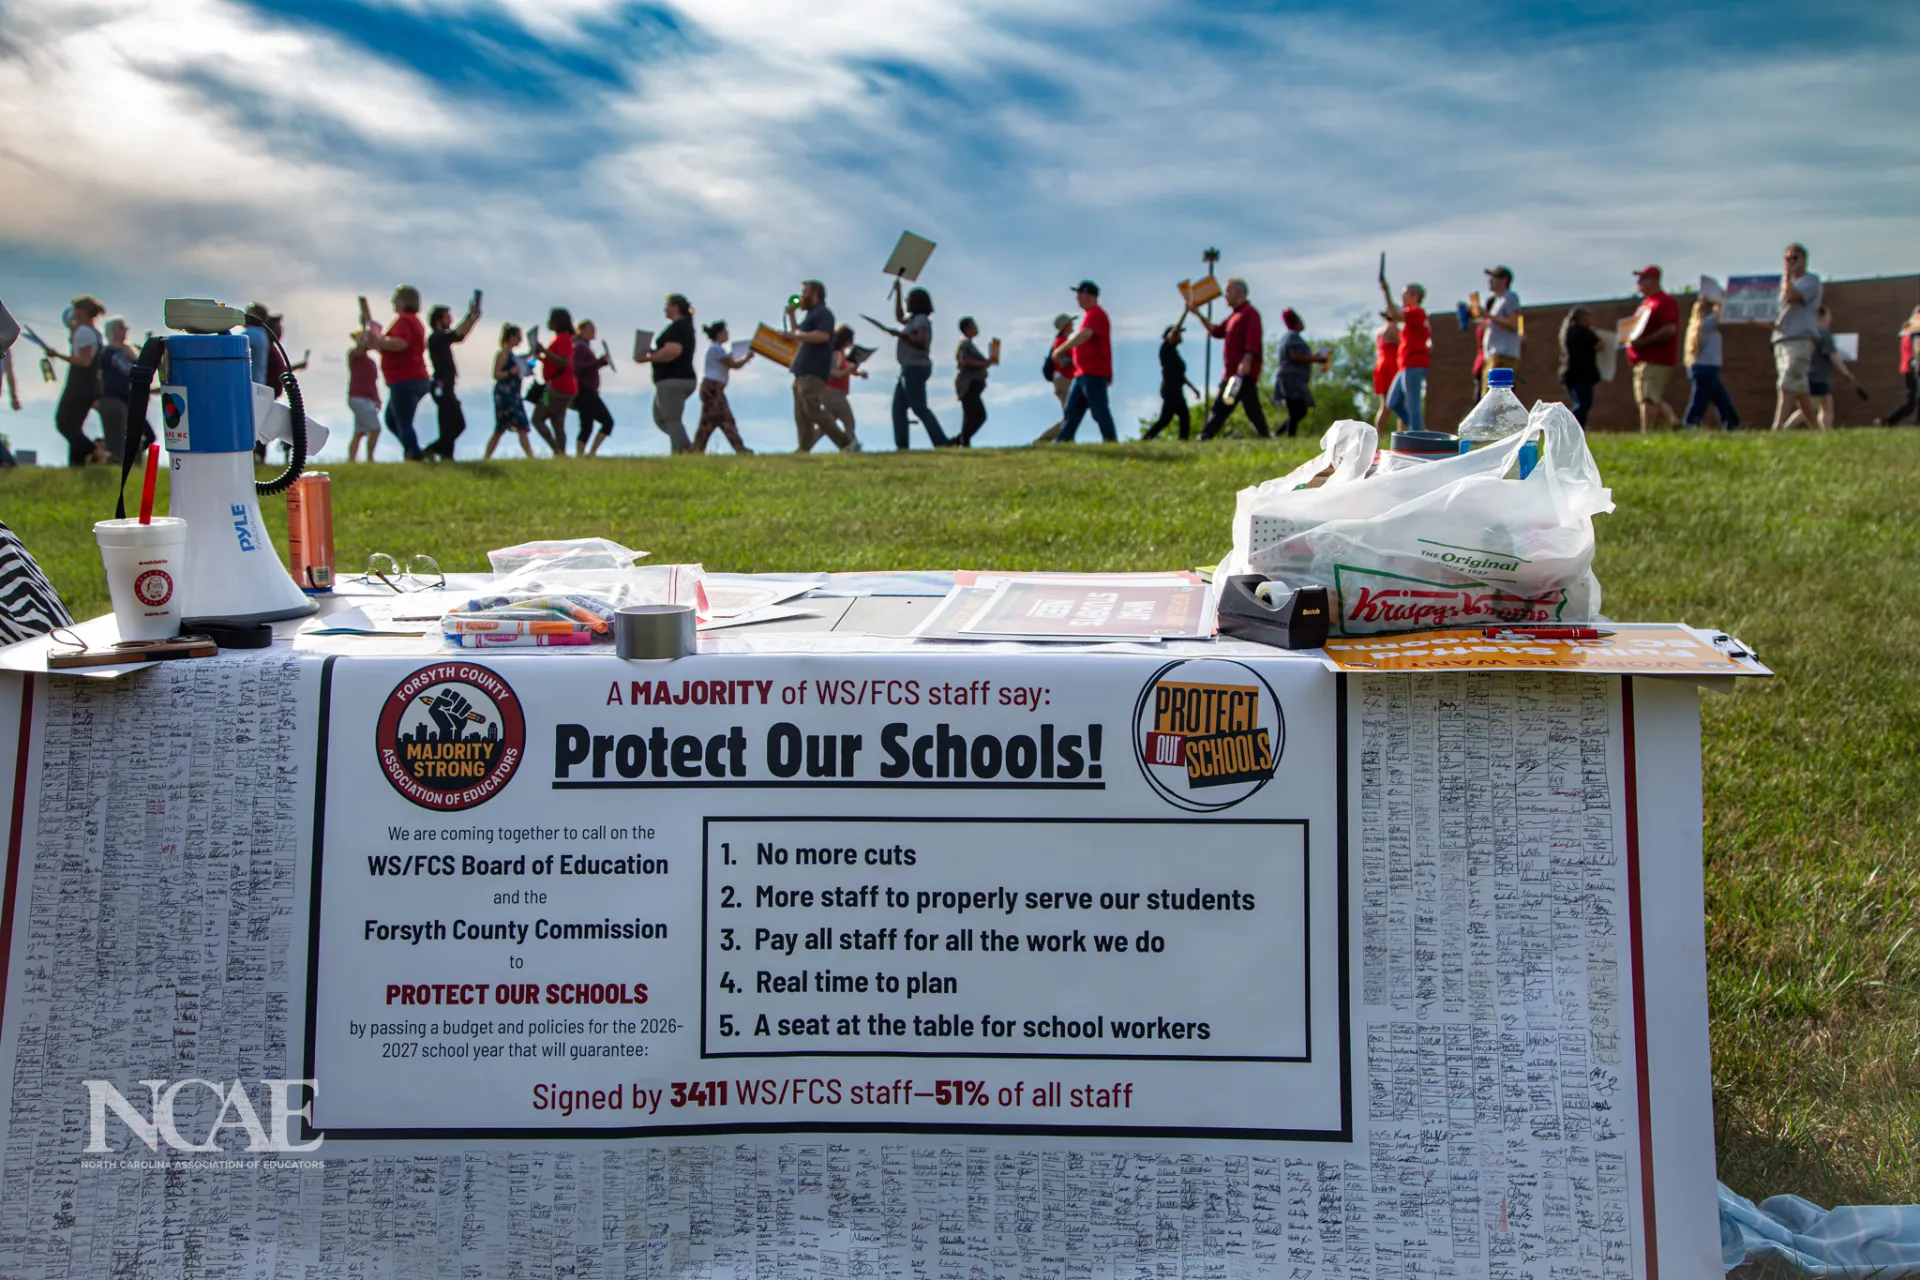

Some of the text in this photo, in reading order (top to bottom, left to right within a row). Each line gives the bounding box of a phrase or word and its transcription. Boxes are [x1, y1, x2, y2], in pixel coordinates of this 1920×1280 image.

[231, 504, 255, 552] PYLE
[1420, 550, 1519, 571] THE Original
[1348, 587, 1459, 625] Krispy
[1370, 645, 1697, 659] Fully Staffed
[397, 667, 509, 702] FORSYTH COUNTY
[607, 680, 1050, 712] A MAJORITY of WS/FCS staff say:
[1154, 686, 1258, 734] PROTECT
[407, 743, 494, 760] MAJORITY
[555, 722, 1102, 779] Protect Our Schools!
[1185, 732, 1273, 778] SCHOOLS
[383, 747, 518, 805] ASSOCIATION OF EDUCATORS
[413, 761, 485, 777] STRONG
[388, 825, 654, 843] We are coming together to call on the
[368, 854, 668, 876] WS/FCS Board of Education
[721, 843, 916, 865] 1. No more cuts
[494, 890, 547, 904] and the
[721, 885, 1255, 915] 2. More staff to properly serve our students
[365, 918, 667, 945] Forsyth County Commission
[721, 928, 1164, 956] 3. Pay all staff for all the work we do
[510, 956, 523, 969] to
[386, 983, 648, 1005] PROTECT OUR SCHOOLS
[720, 969, 957, 999] 4. Real time to plan
[350, 1018, 683, 1038] by passing a budget and policies for the 2026-
[720, 1013, 1210, 1040] 5. A seat at the table for school workers
[383, 1042, 648, 1061] 2027 school year that will guarantee:
[533, 1084, 622, 1116] Signed
[633, 1084, 662, 1115] by
[670, 1081, 727, 1107] 3411
[736, 1079, 841, 1105] WS/FCS
[998, 1081, 1024, 1106] of
[1033, 1082, 1060, 1107] all
[1070, 1083, 1132, 1108] staff
